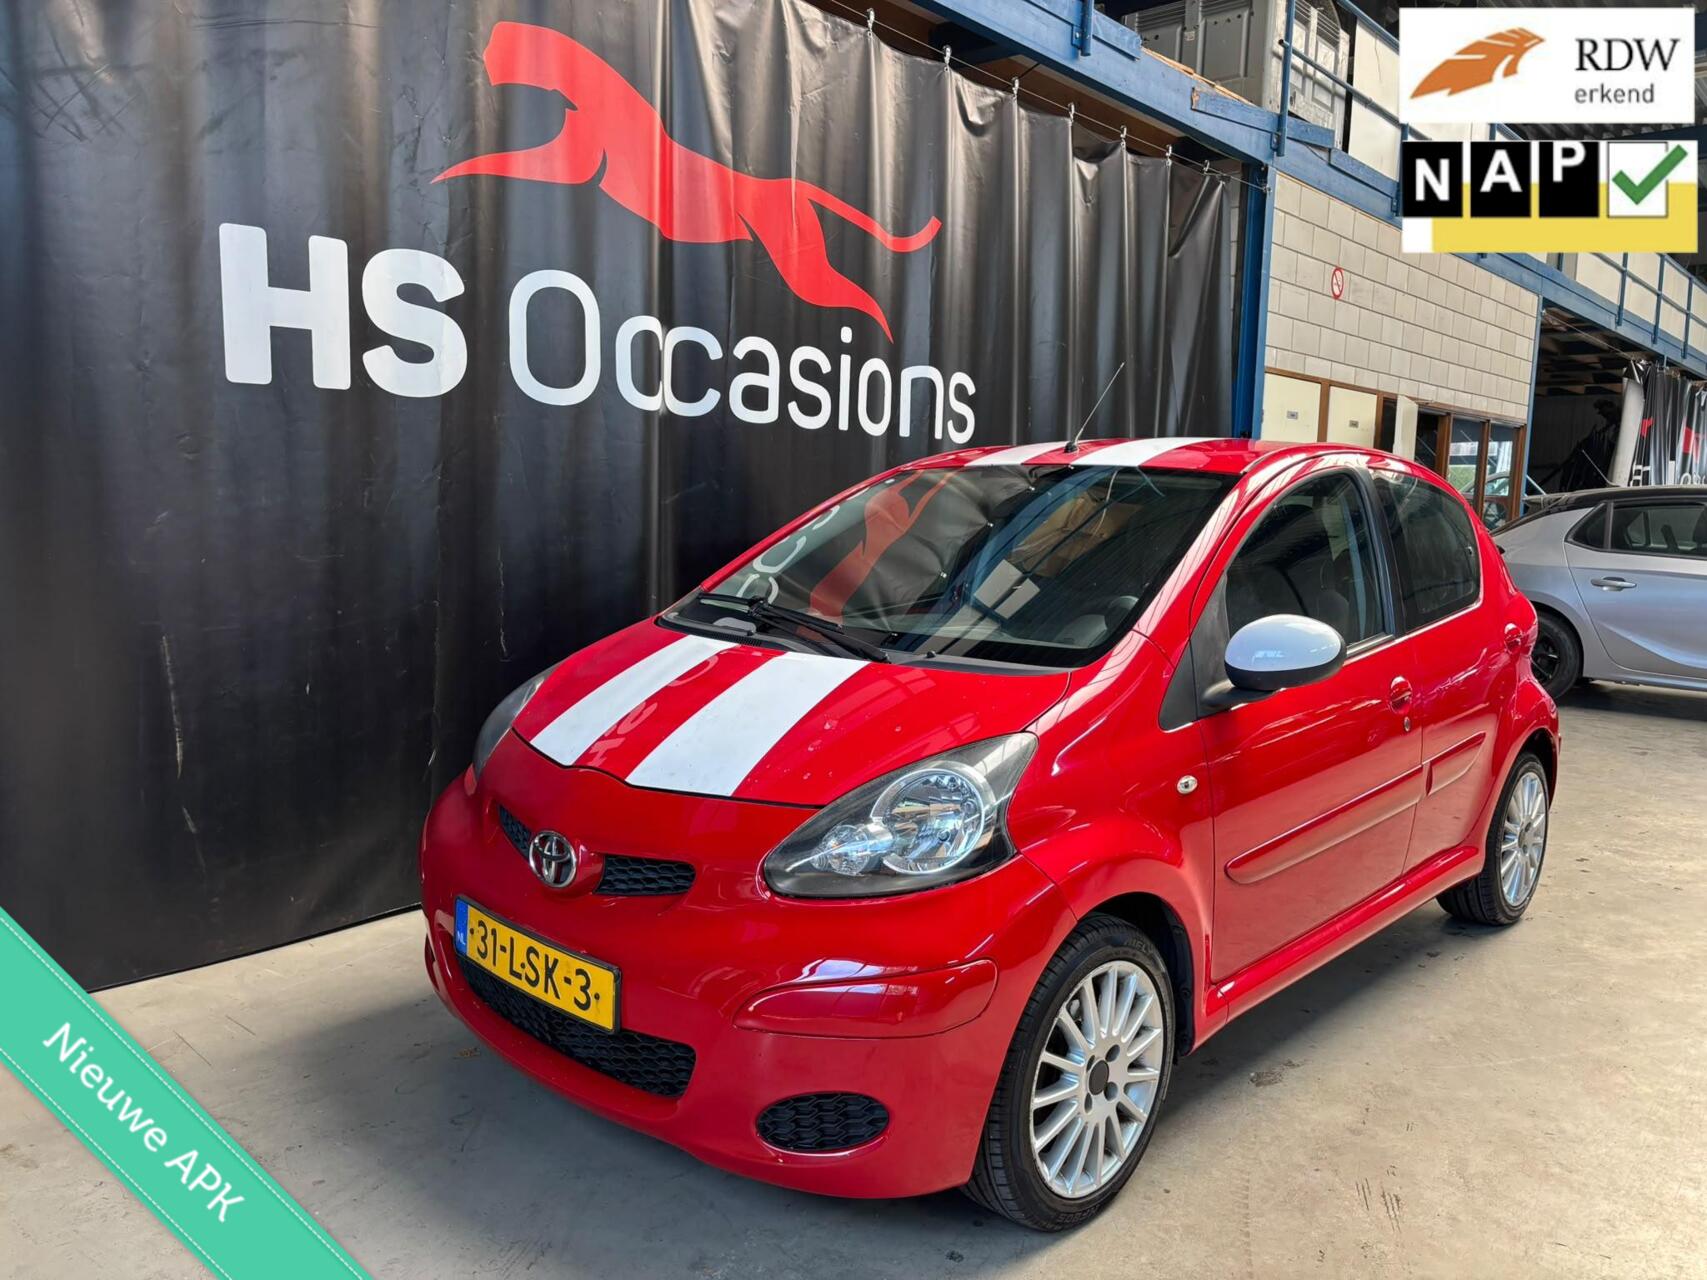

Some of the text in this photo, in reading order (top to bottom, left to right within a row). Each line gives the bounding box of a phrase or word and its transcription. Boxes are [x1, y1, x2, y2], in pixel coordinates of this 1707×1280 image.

[219, 222, 977, 445] HS Occasions
[476, 919, 593, 1012] 31-LSK-3
